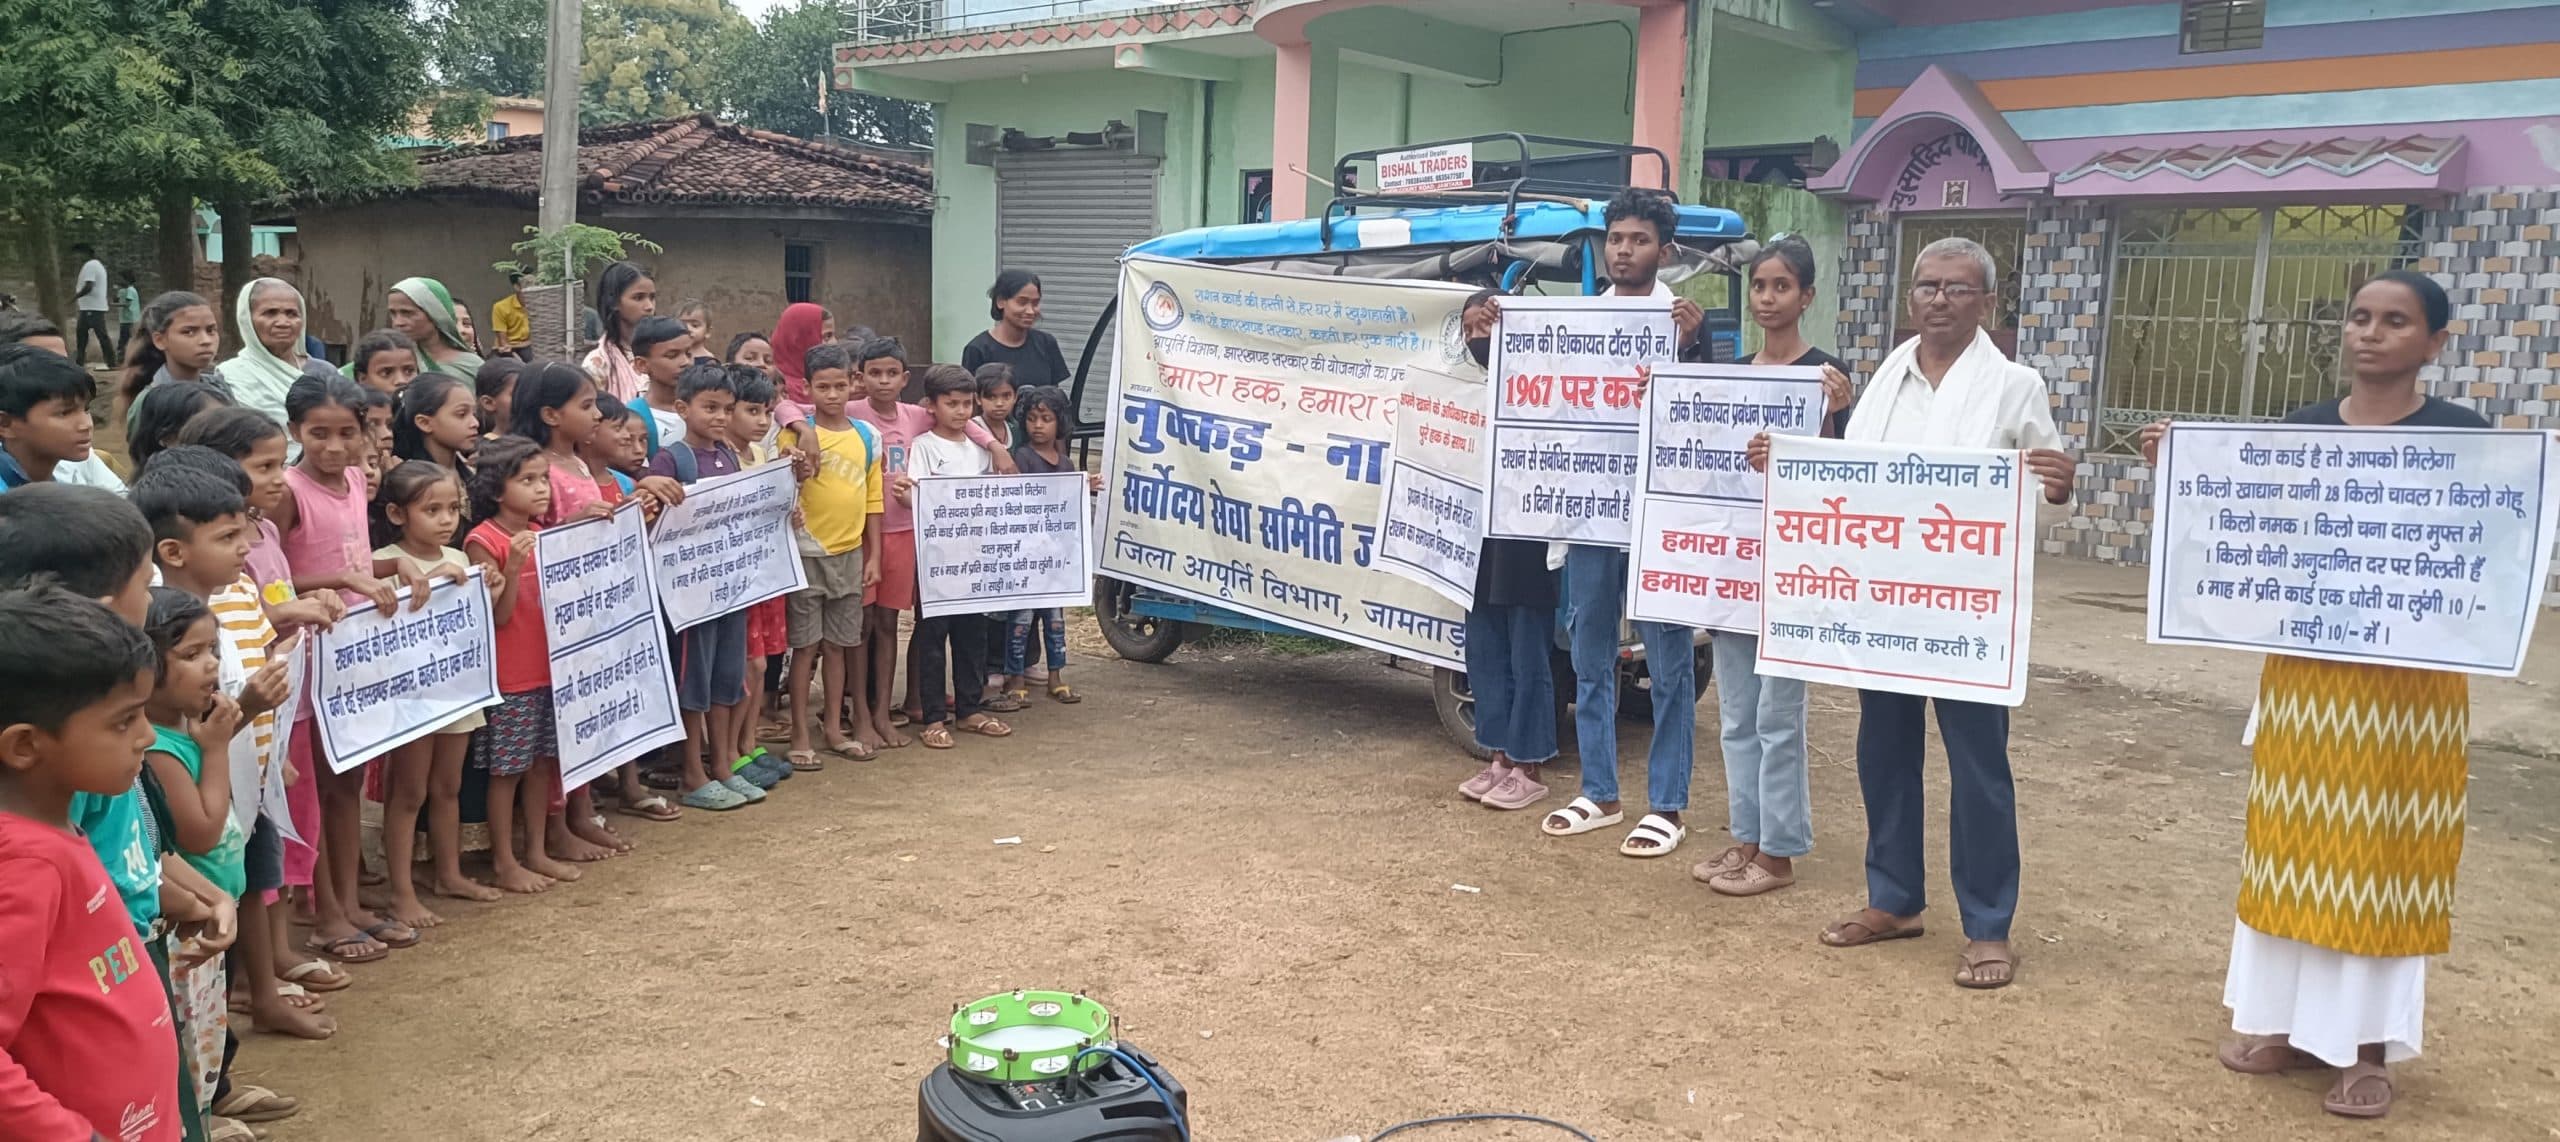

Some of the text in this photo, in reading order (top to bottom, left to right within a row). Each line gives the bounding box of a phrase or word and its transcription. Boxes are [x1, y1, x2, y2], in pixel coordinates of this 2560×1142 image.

[1381, 162, 1417, 178] BISHAL
[1420, 155, 1467, 173] TRADERS
[1244, 291, 1258, 308] की
[1299, 302, 1312, 316] हर
[1316, 304, 1331, 318] घर
[1506, 333, 1535, 353] राशन
[1538, 325, 1553, 355] की
[1556, 325, 1605, 355] शिकायत
[1609, 328, 1633, 356] टॉल
[1655, 335, 1670, 356] न.
[1224, 346, 1269, 365] झारखण्ड
[1272, 352, 1308, 371] सरकार
[1311, 353, 1326, 372] की
[1374, 366, 1390, 380] का
[1231, 376, 1286, 411] हक,
[1298, 385, 1373, 422] हमारा
[1506, 374, 1597, 408] 1967 पर
[1670, 392, 1690, 423] लोक
[1693, 392, 1730, 424] शिकायत
[1762, 395, 1793, 430] प्रणाली
[1794, 397, 1806, 428] में
[1124, 394, 1390, 485] नुक्कड़ ना
[1656, 438, 1732, 472] राशन की शिकायत
[2240, 442, 2456, 470] पीला कार्ड है तो आपको मिलेगा
[1501, 442, 1622, 474] राशन से समस्या का
[1776, 452, 2012, 488] जागरूकता अभियान में
[1000, 484, 1023, 496] आपको
[1025, 482, 1047, 496] मिलेगा
[1522, 493, 1531, 512] 15
[1555, 487, 1565, 515] में
[1566, 495, 1584, 518] हल
[1585, 488, 1596, 518] हो
[1598, 489, 1620, 518] जाती
[1622, 490, 1630, 522] है
[2178, 480, 2192, 496] 35
[2196, 474, 2232, 498] किलो
[2288, 478, 2322, 500] यानी
[2324, 486, 2340, 502] 28
[2344, 478, 2384, 504] किलो
[2388, 486, 2432, 506] चावल
[2436, 489, 2444, 506] 7
[2448, 482, 2490, 508] किलो
[933, 505, 947, 520] प्रति
[970, 503, 983, 518] प्रति
[985, 506, 997, 517] माह
[1005, 502, 1022, 516] किलो
[1123, 464, 1204, 530] सर्वोदय
[1210, 479, 1252, 544] सेवा
[1258, 496, 1344, 564] समिति
[1774, 496, 2006, 556] सर्वोदय सेवा
[924, 520, 1062, 539] प्रति कार्ड प्रति माह किलो नमक किलो
[1662, 529, 1729, 556] हमारा
[2220, 508, 2256, 533] किलो
[2258, 517, 2299, 534] नमक
[2314, 512, 2354, 538] किलो
[2357, 520, 2387, 539] चना
[2392, 522, 2423, 542] दाल
[2426, 524, 2464, 552] मुफ्त
[981, 544, 995, 554] दाल
[2216, 541, 2253, 566] किलो
[2256, 543, 2288, 568] चीनी
[2292, 548, 2362, 579] अनुदानित
[2366, 556, 2387, 574] दर
[2390, 558, 2412, 576] पर
[2415, 552, 2466, 580] मिलती
[544, 556, 582, 590] झारखण्ड
[945, 566, 958, 576] माह
[968, 560, 981, 576] प्रति
[983, 560, 998, 573] कार्ड
[999, 562, 1010, 572] एक
[1642, 569, 1759, 601] हमारा राश
[1114, 530, 1466, 657] जिला आपूर्ति विभाग, जामताड़
[1774, 564, 2001, 620] समिति जामताड़ा
[2197, 576, 2464, 622] 6 माह में प्रति कार्ड एक धोती या लुंगी 10
[554, 601, 575, 636] भूखा
[2290, 615, 2324, 644] साड़ी
[2364, 620, 2381, 644] में
[1770, 622, 1988, 660] आपका हार्दिक स्वागत करती है
